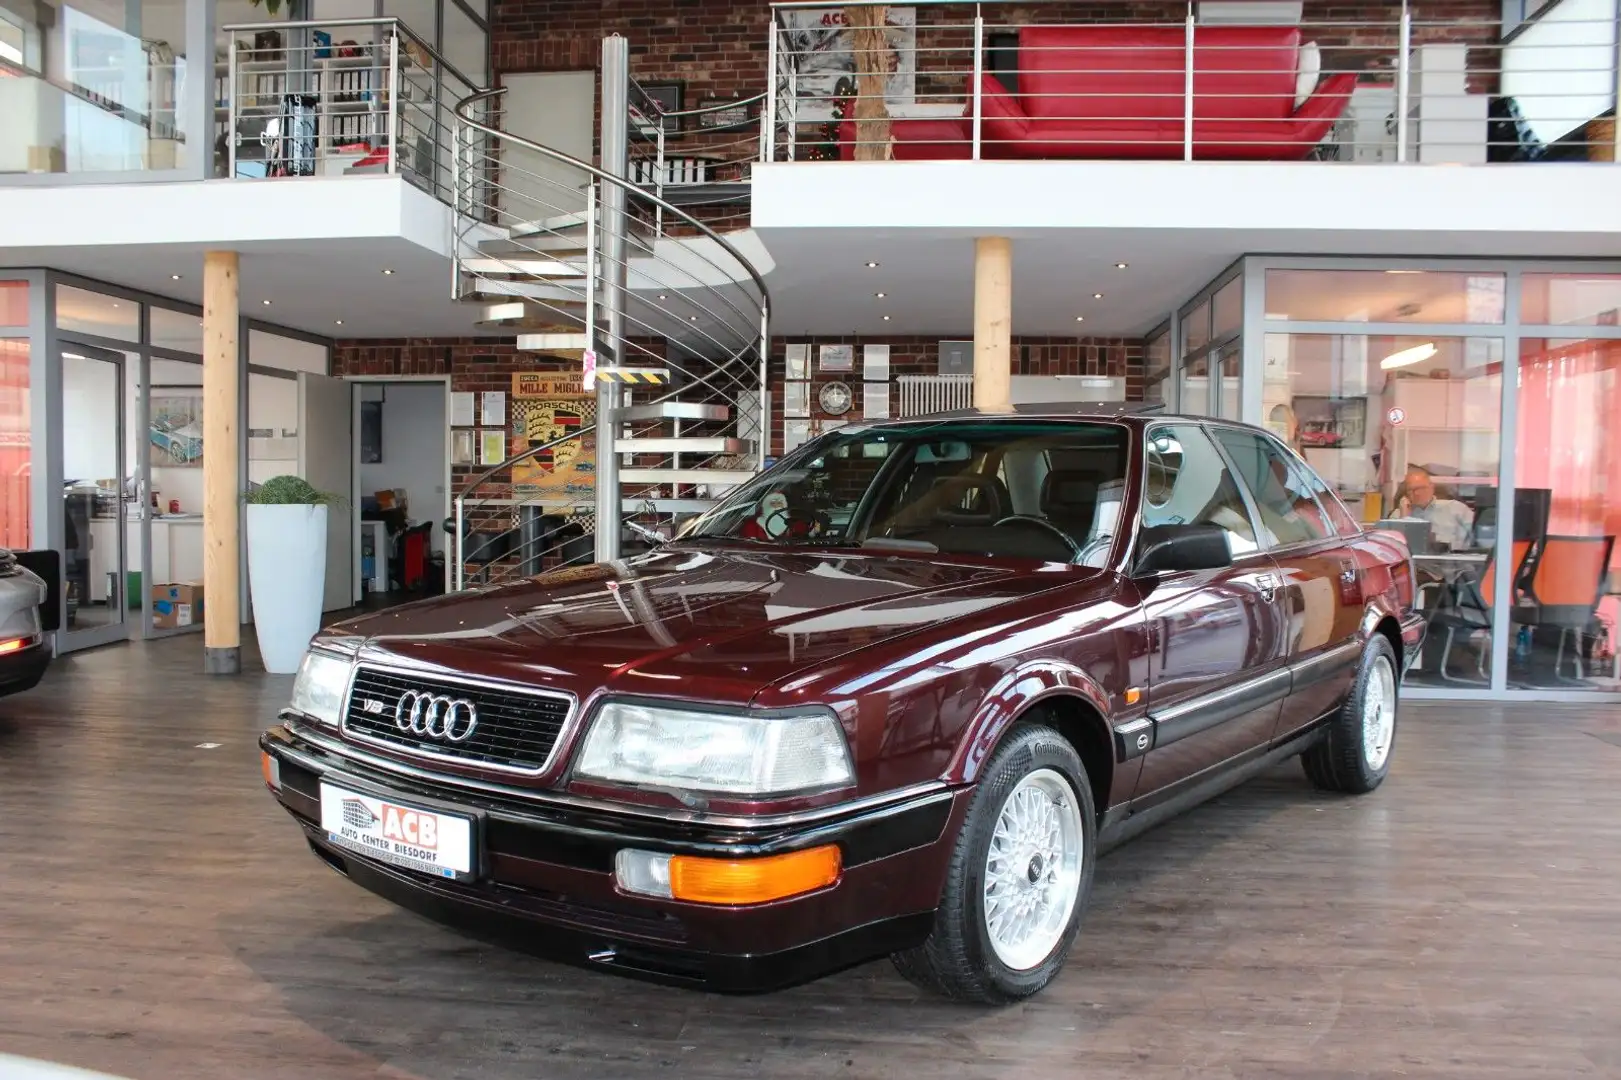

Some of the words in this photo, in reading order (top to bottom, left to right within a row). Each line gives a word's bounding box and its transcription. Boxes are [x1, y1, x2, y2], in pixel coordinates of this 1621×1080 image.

[520, 383, 548, 394] MILLE
[554, 383, 587, 394] MIGLI
[528, 402, 581, 413] PORSCHE
[385, 808, 436, 846] ACB
[341, 826, 358, 840] AUTO
[362, 834, 390, 850] CENTER
[394, 844, 437, 862] BIESDORF
